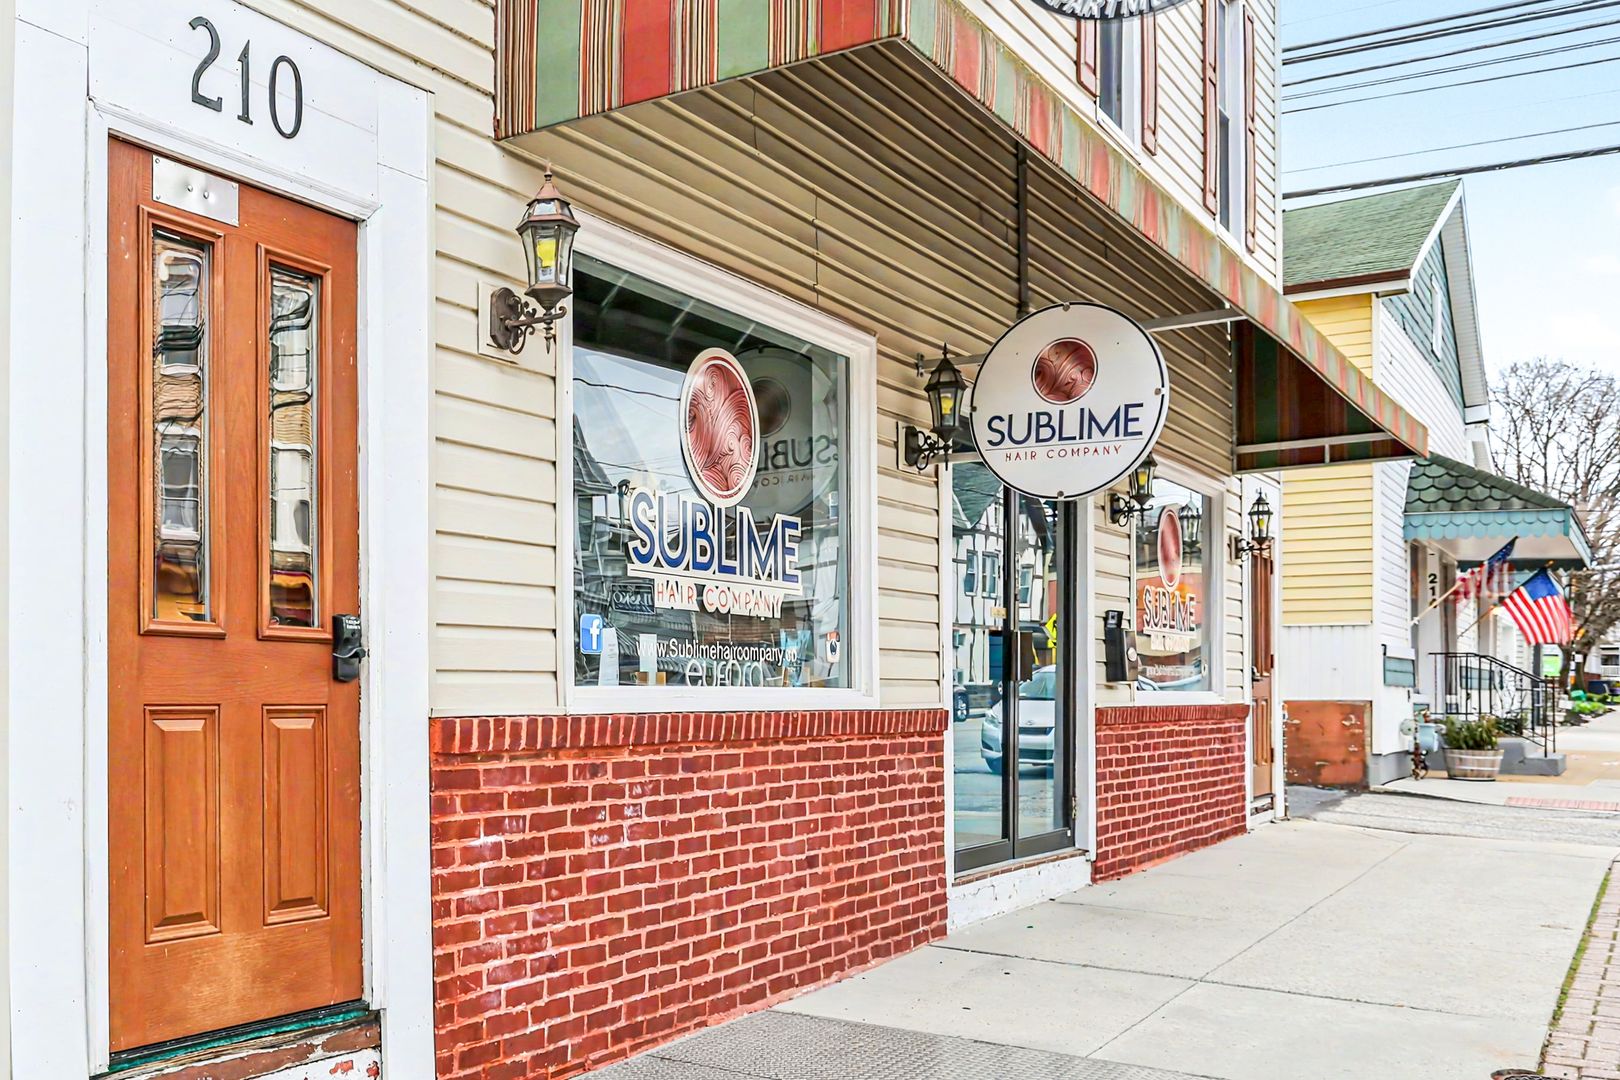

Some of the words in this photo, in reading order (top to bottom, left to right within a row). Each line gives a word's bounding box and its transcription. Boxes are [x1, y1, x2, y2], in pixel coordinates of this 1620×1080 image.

[188, 16, 303, 139] 210
[987, 403, 1144, 447] SUBLIME
[1005, 450, 1037, 462] HAIR
[1046, 445, 1122, 459] COMPANY
[630, 490, 800, 585] SUBLIME
[657, 582, 695, 604] HAIR
[705, 587, 782, 613] COMPANY
[1144, 588, 1196, 632] SUBLIME
